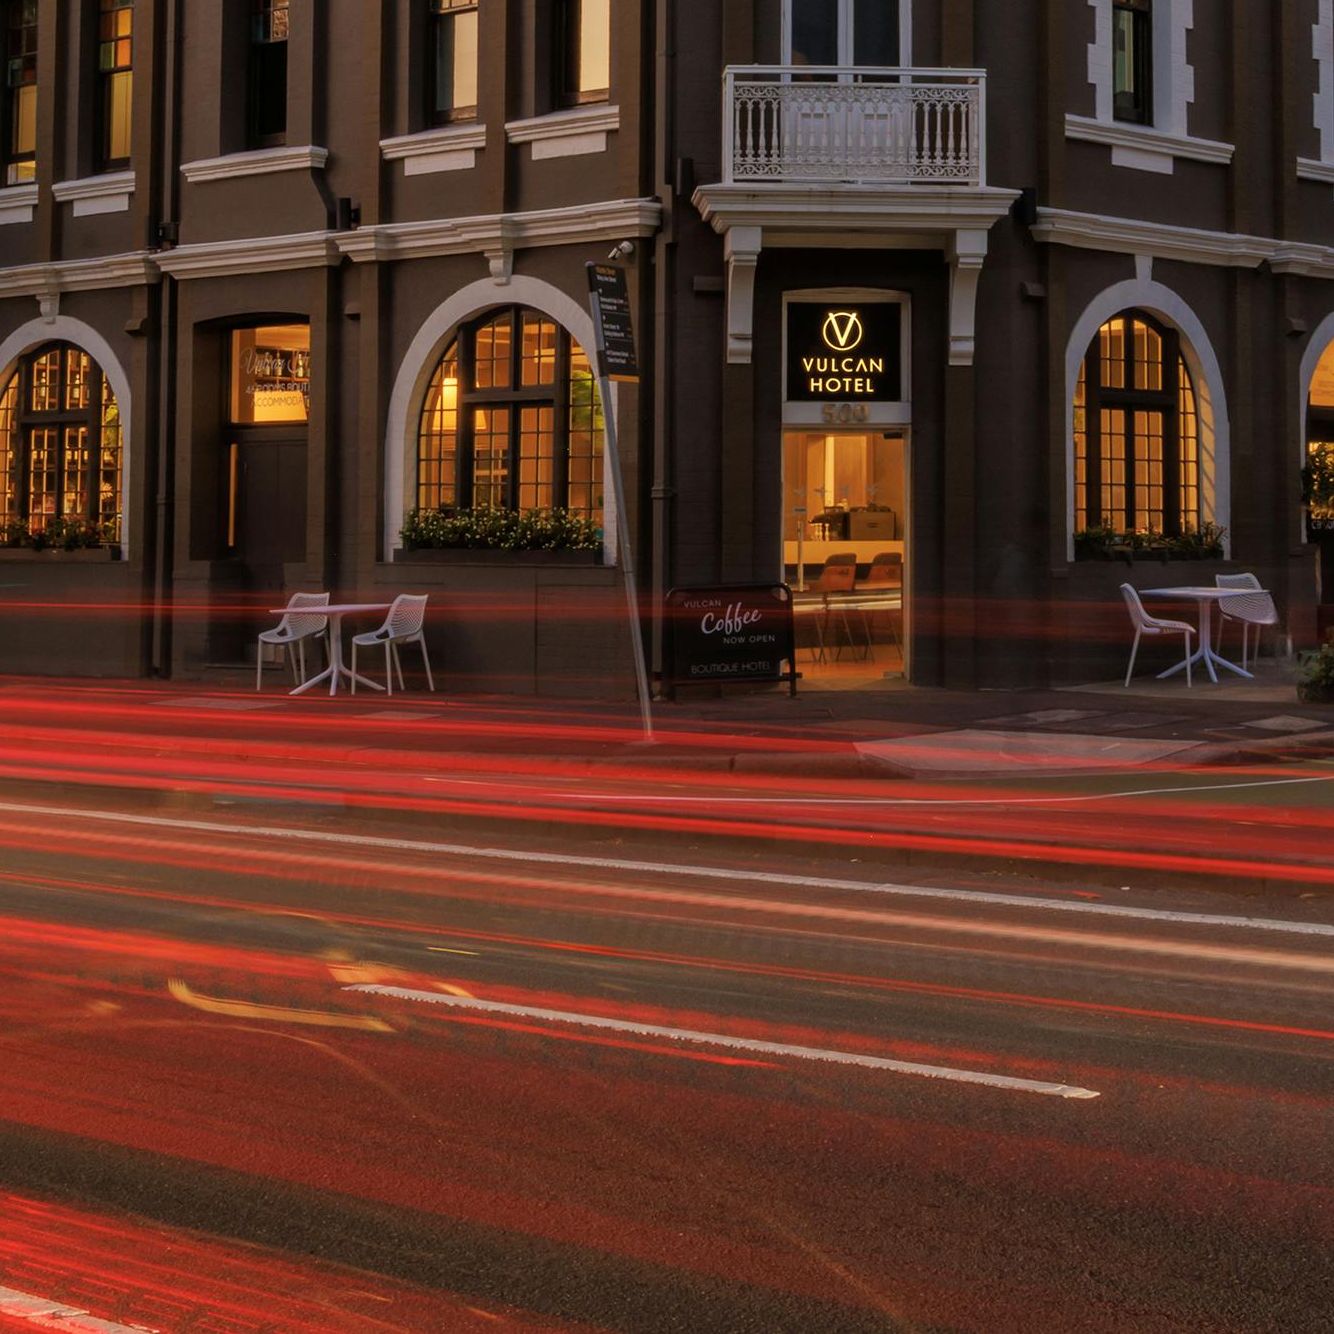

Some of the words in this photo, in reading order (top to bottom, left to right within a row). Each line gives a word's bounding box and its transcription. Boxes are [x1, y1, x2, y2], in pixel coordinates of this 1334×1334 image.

[802, 357, 883, 372] VULCAN
[810, 377, 874, 392] HOTEL
[822, 404, 871, 423] 500
[684, 599, 722, 608] VULCAN
[701, 601, 762, 635] Coffee
[722, 636, 746, 645] NOW
[748, 634, 775, 643] OPEN
[691, 662, 739, 674] BOUTIQUE
[741, 660, 771, 672] HOTEL
